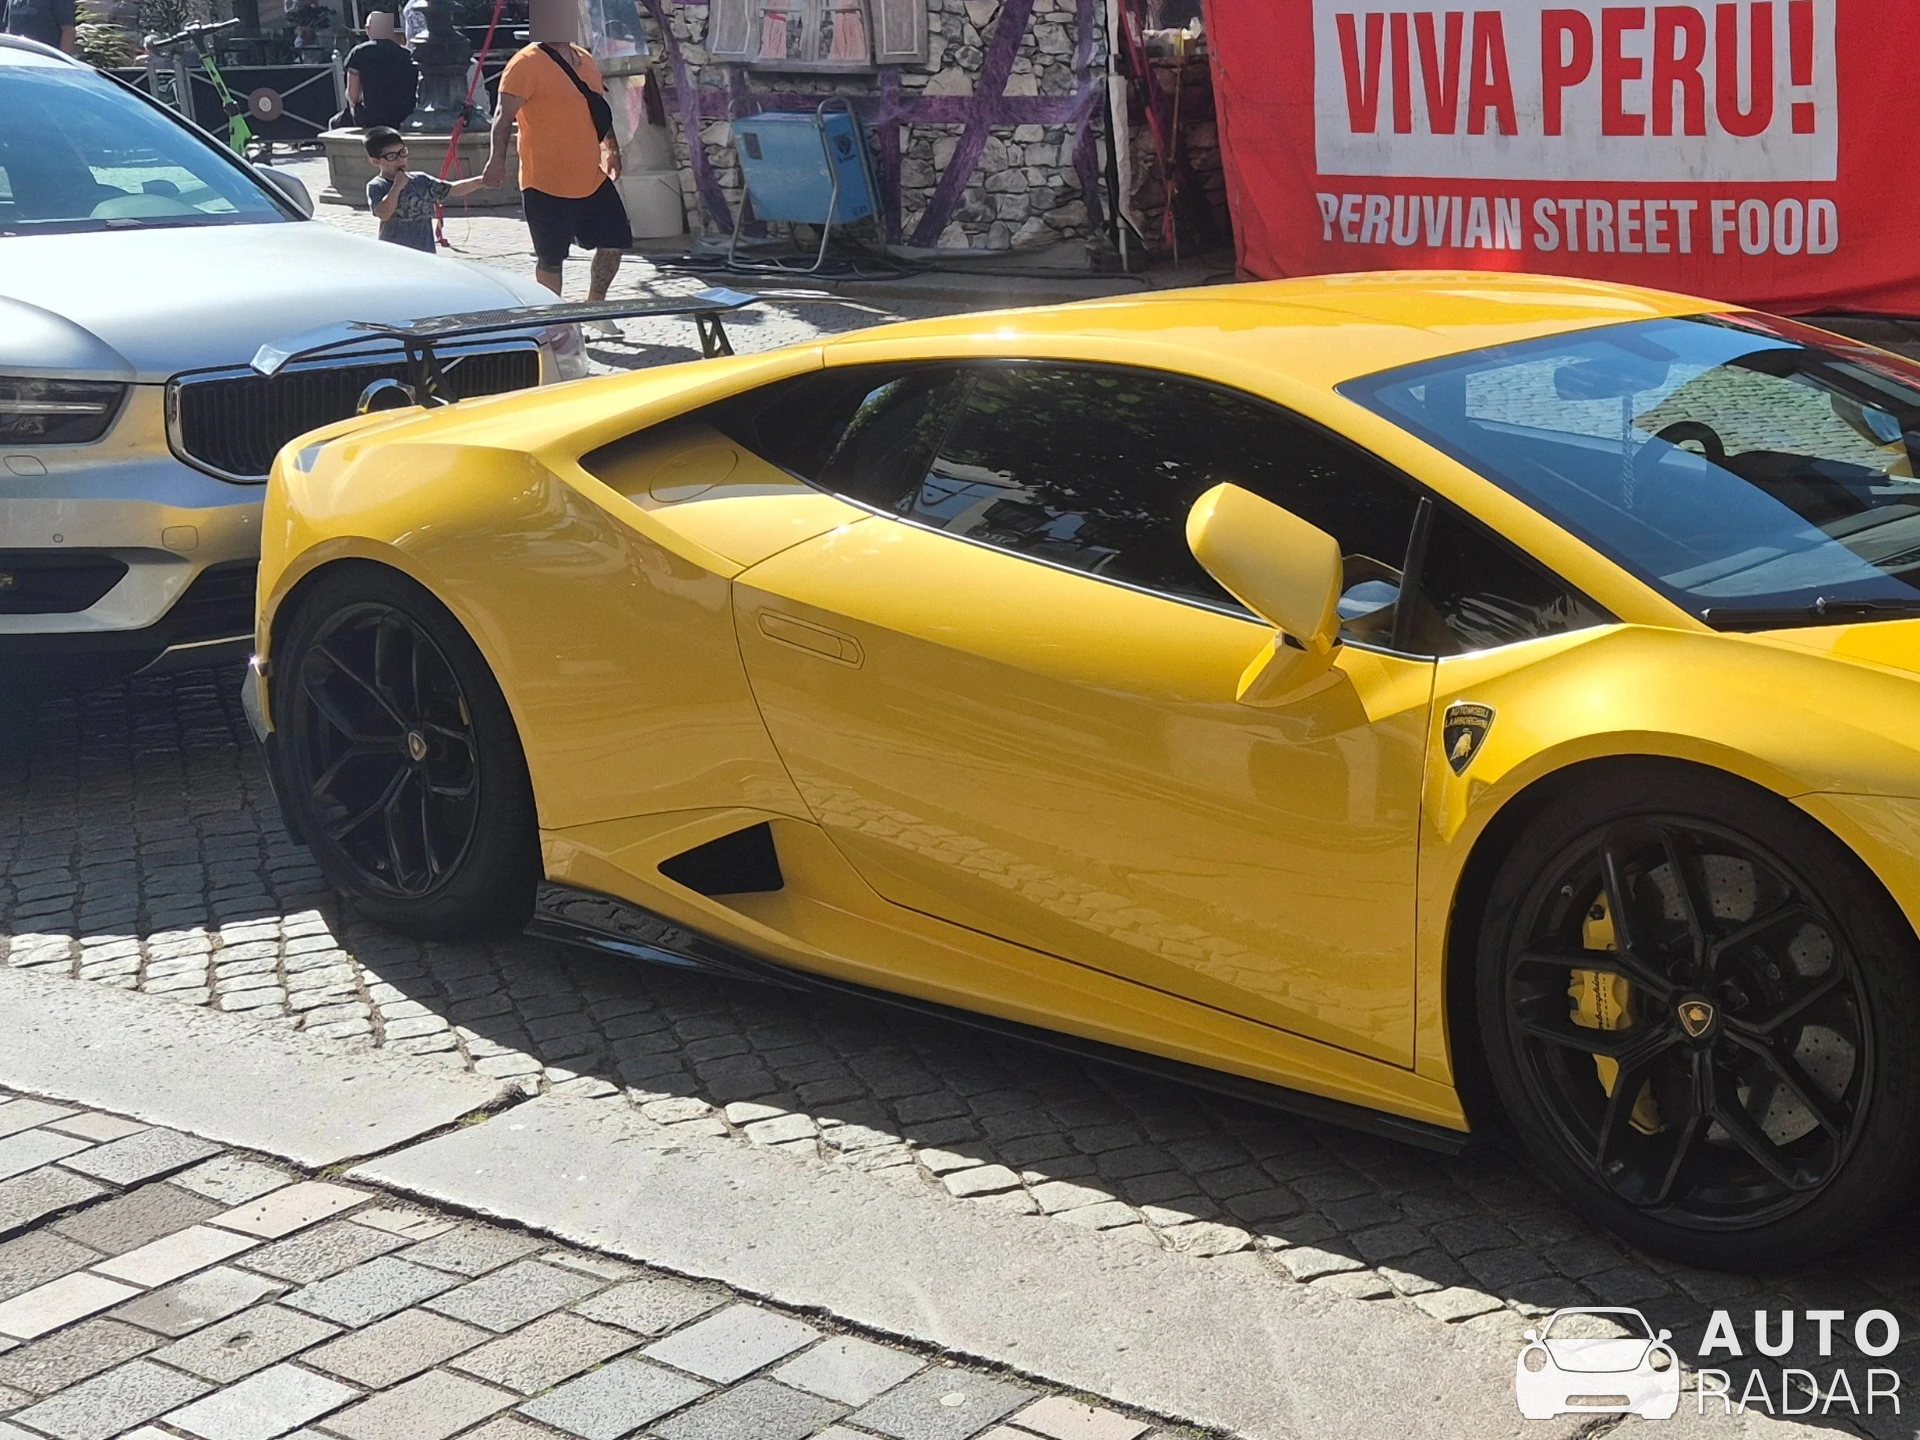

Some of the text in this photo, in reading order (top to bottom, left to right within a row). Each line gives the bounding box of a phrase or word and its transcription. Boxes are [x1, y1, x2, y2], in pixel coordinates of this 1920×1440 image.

[1335, 1, 1815, 137] VIVA PERU!
[1316, 193, 1839, 255] PERUVIAN STREET FOOD
